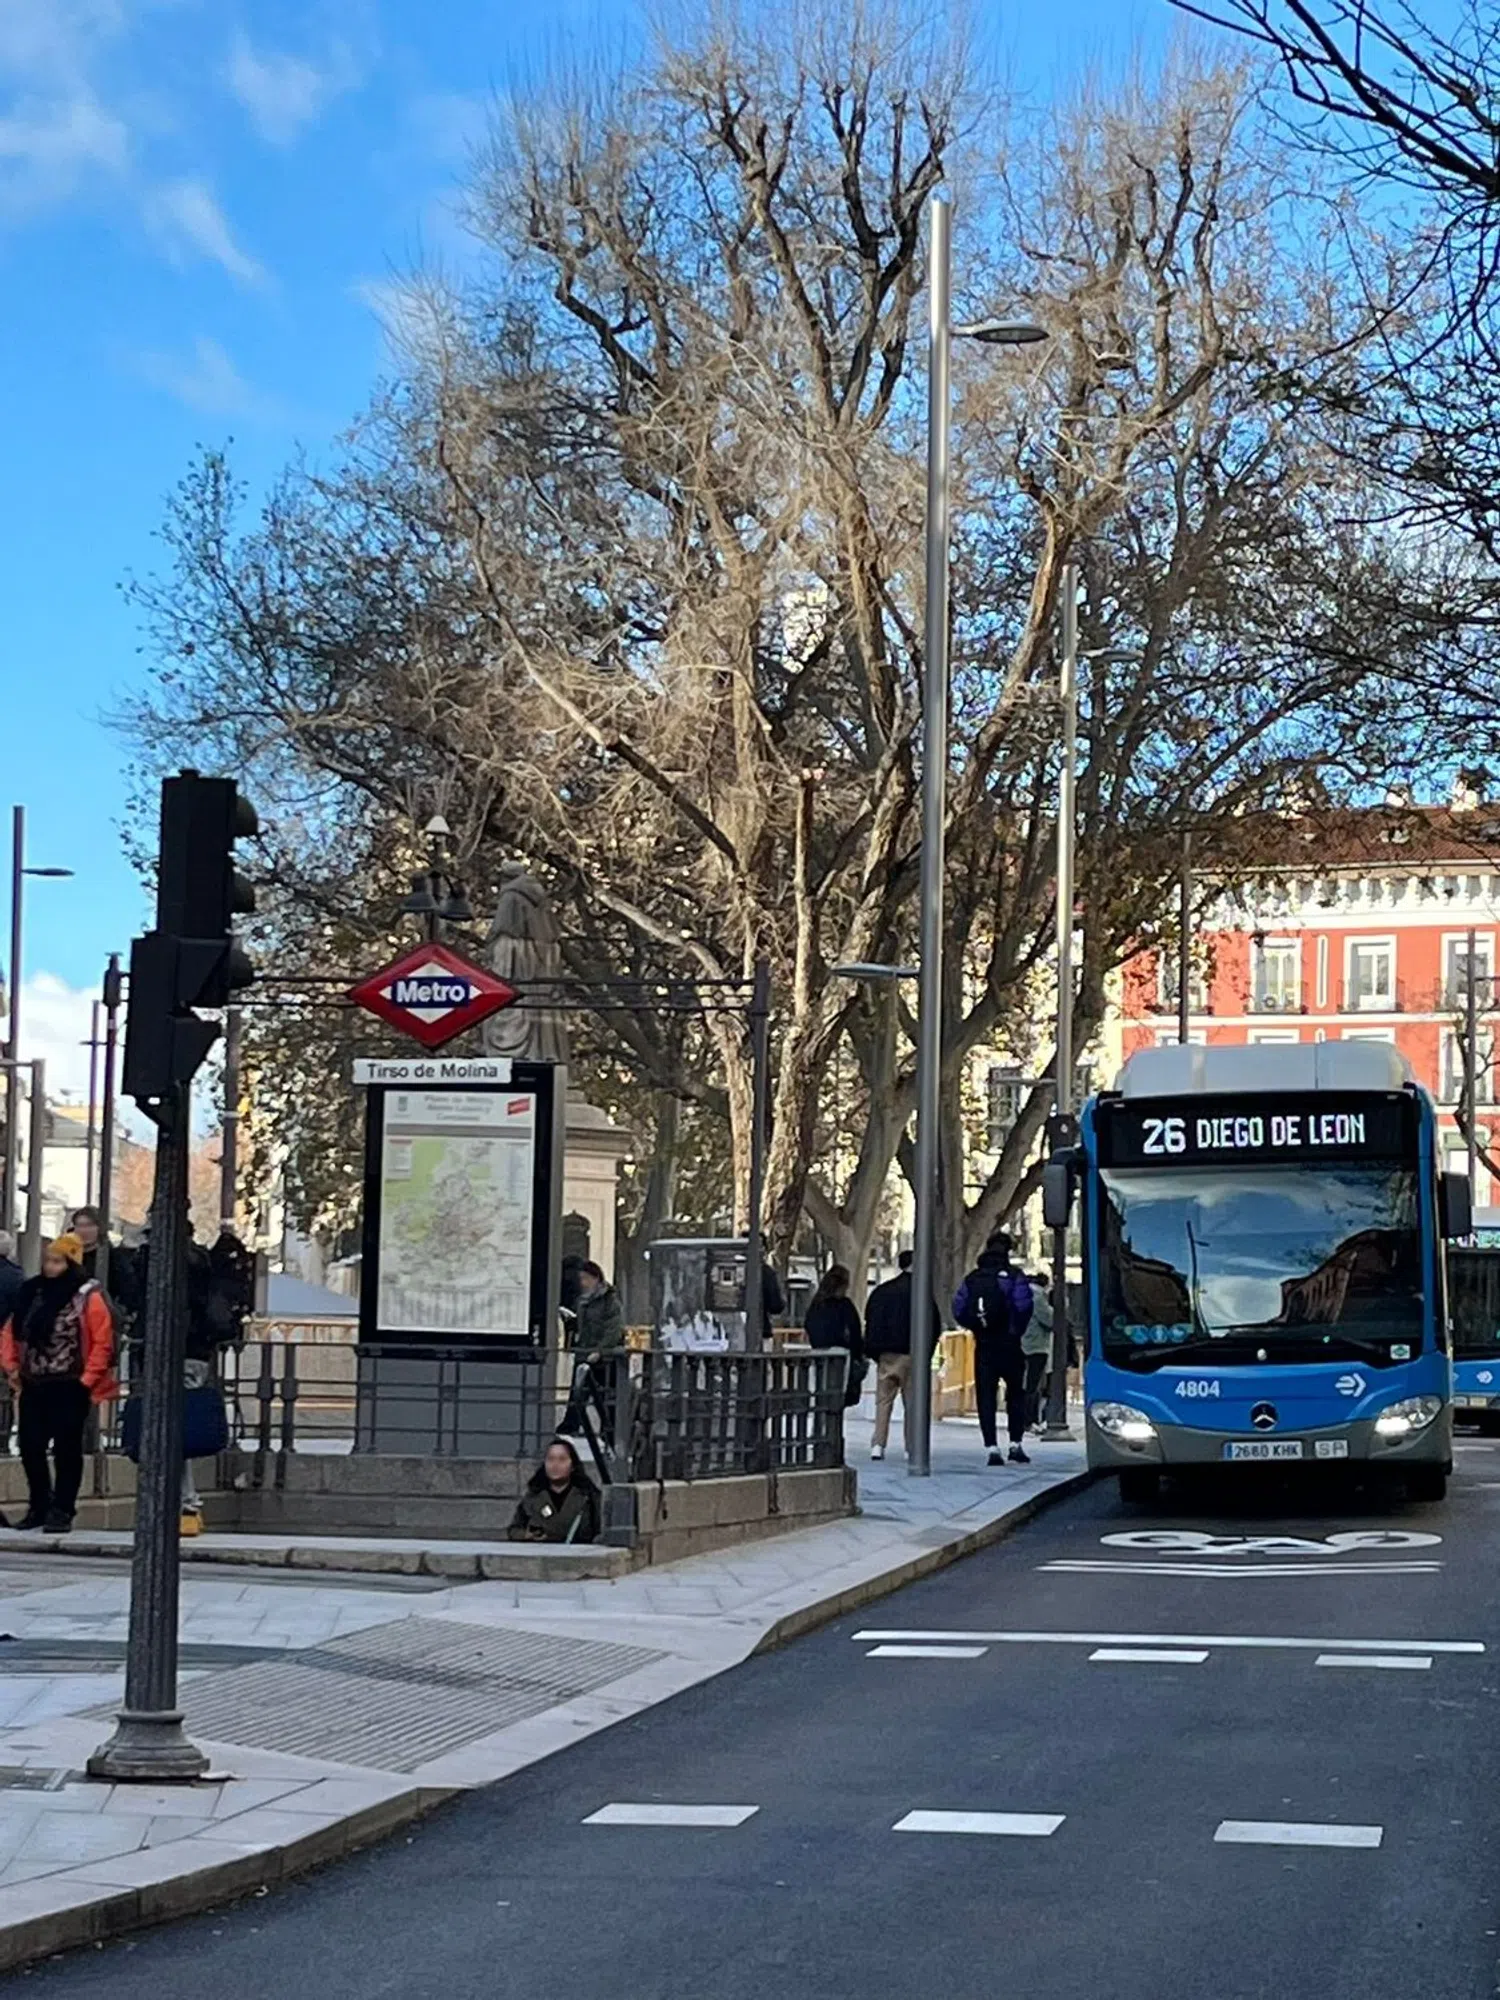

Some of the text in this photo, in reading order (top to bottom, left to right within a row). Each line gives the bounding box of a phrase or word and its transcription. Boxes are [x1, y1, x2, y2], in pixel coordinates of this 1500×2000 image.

[396, 980, 466, 1003] Metro
[367, 1062, 498, 1078] Tirso de Molina
[1142, 1113, 1366, 1154] 26 DIEGO DE LEON
[1174, 1380, 1221, 1398] 4804
